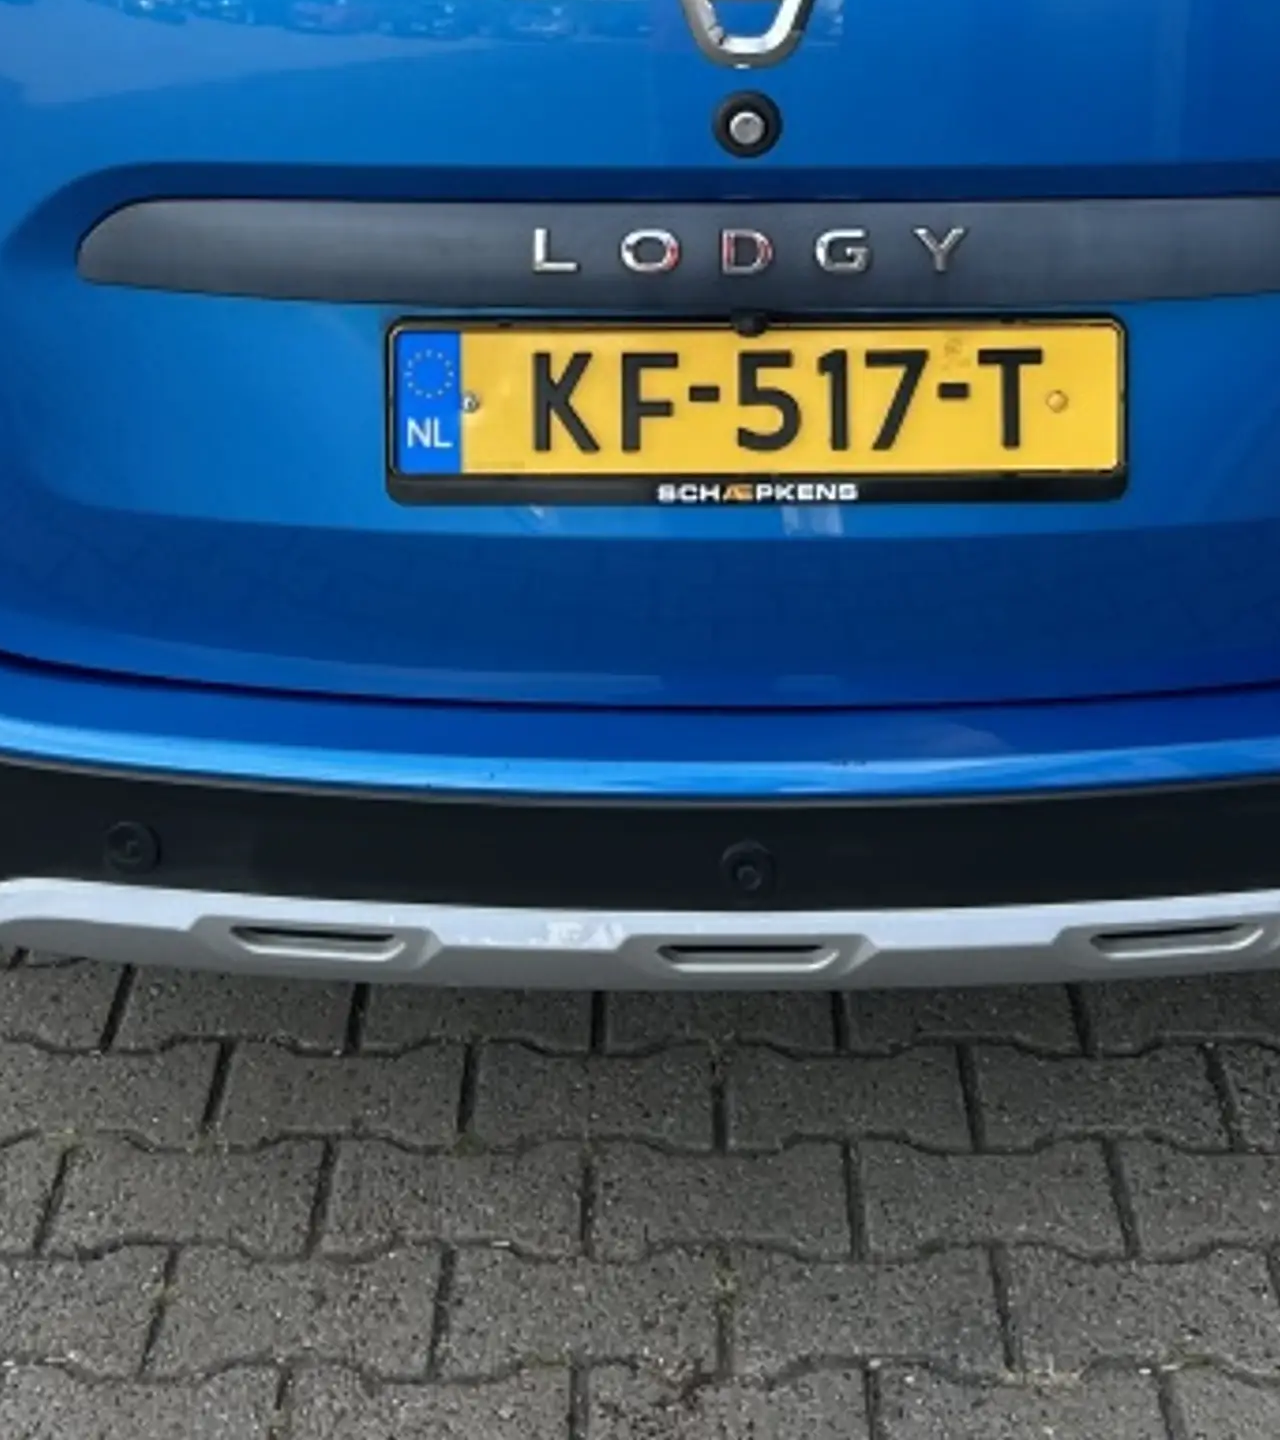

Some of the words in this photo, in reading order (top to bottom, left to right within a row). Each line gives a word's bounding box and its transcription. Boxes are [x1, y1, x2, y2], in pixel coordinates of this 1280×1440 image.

[532, 227, 965, 273] LODGY
[532, 348, 1044, 453] KF-517-T
[406, 416, 454, 448] NL
